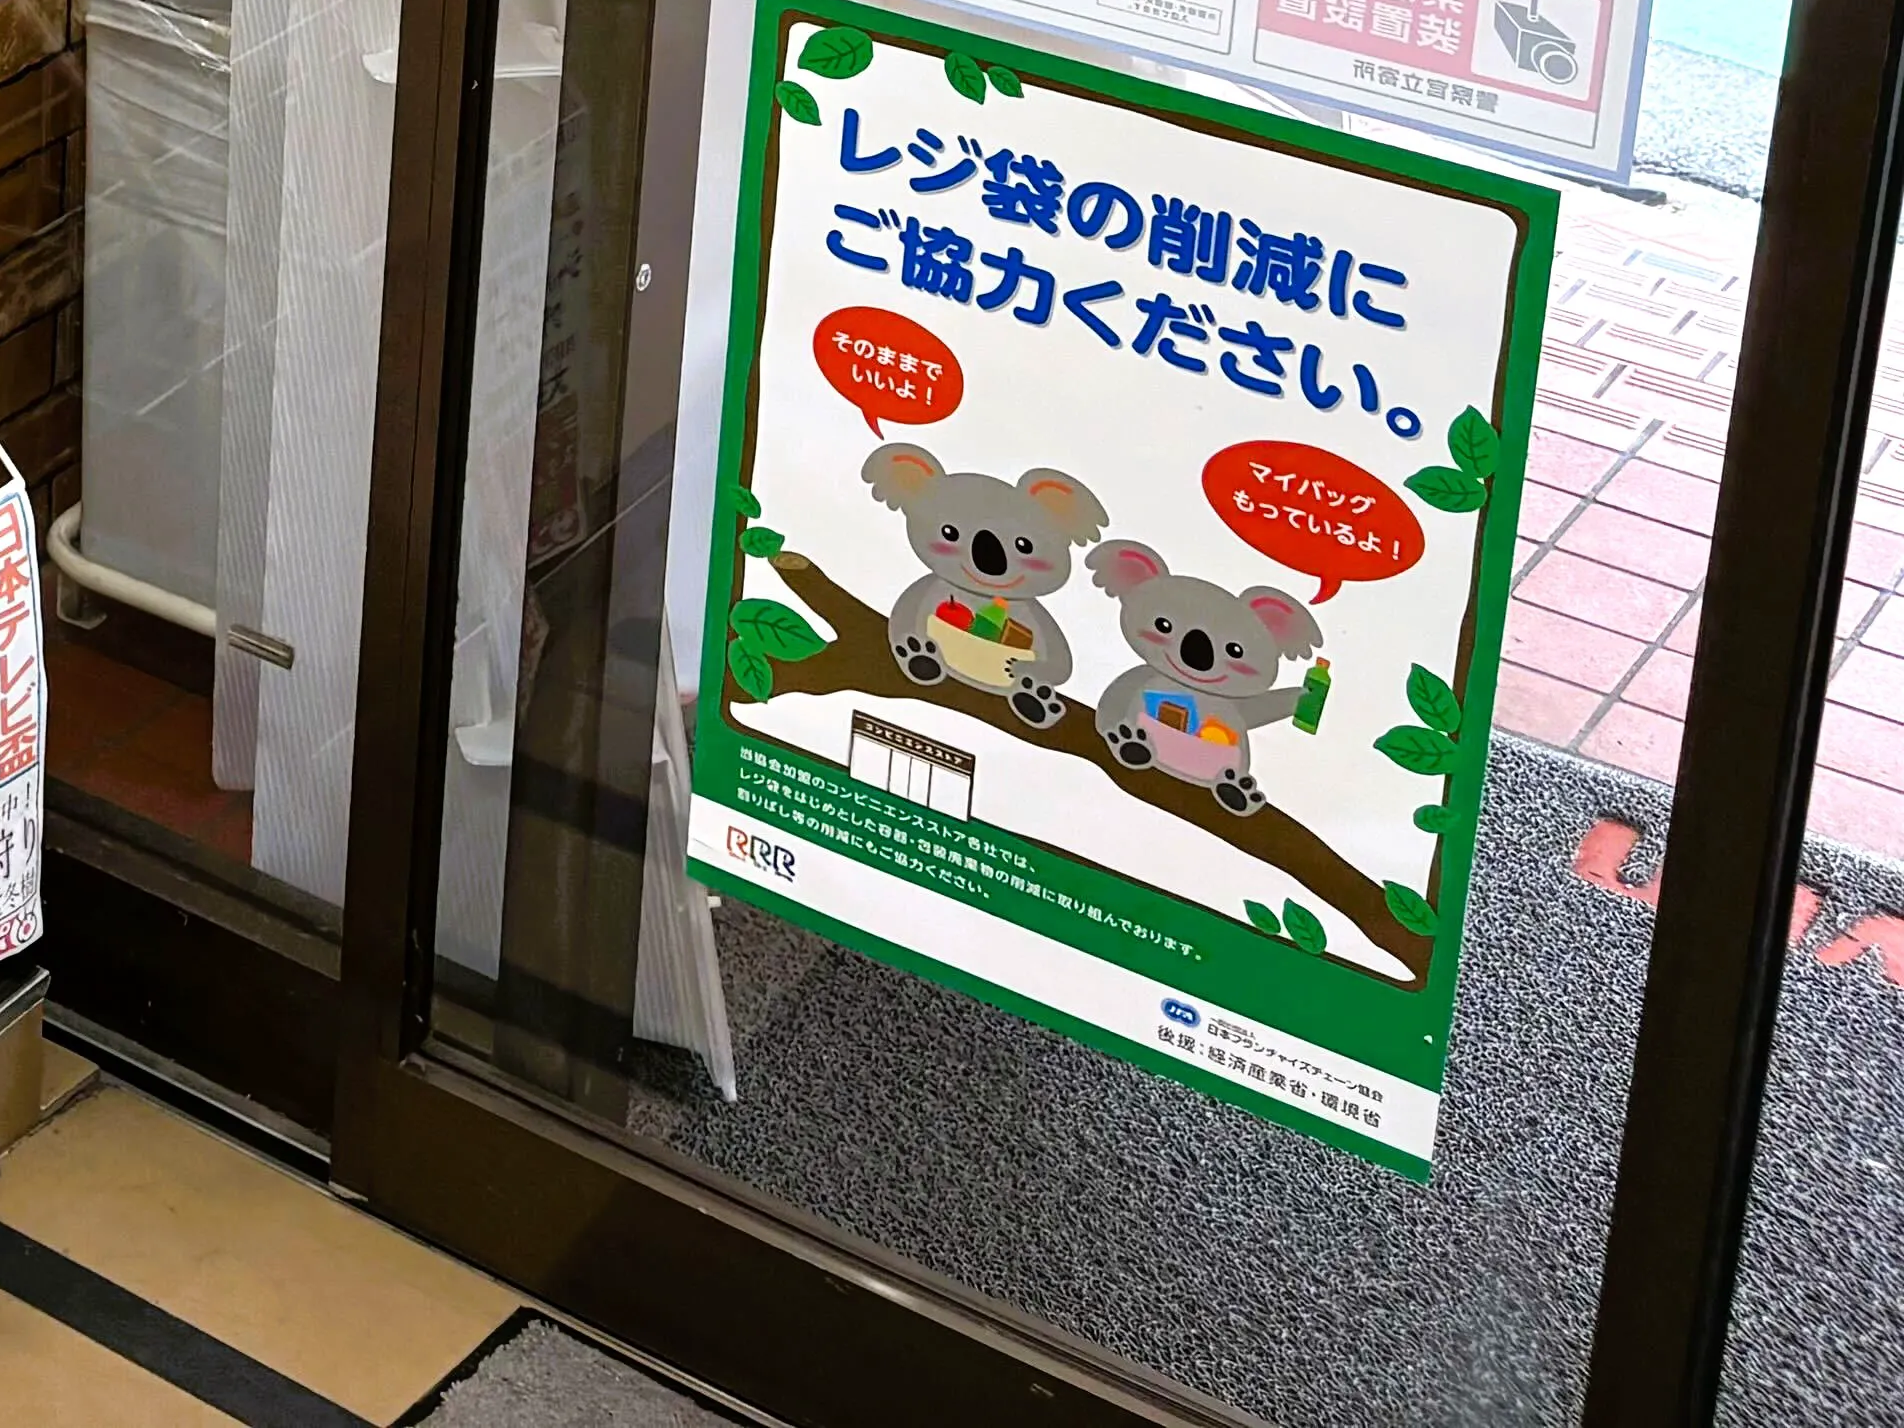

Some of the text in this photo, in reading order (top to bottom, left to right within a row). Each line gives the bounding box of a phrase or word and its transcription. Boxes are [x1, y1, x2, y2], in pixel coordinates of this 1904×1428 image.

[836, 106, 1409, 329] レジ袋の削減に
[826, 204, 1426, 442] ご協力ください。
[831, 329, 945, 383] そのままで
[849, 362, 934, 407] いいよ!
[1248, 458, 1379, 514] マイバッグ
[1231, 487, 1403, 561] もっているよ!
